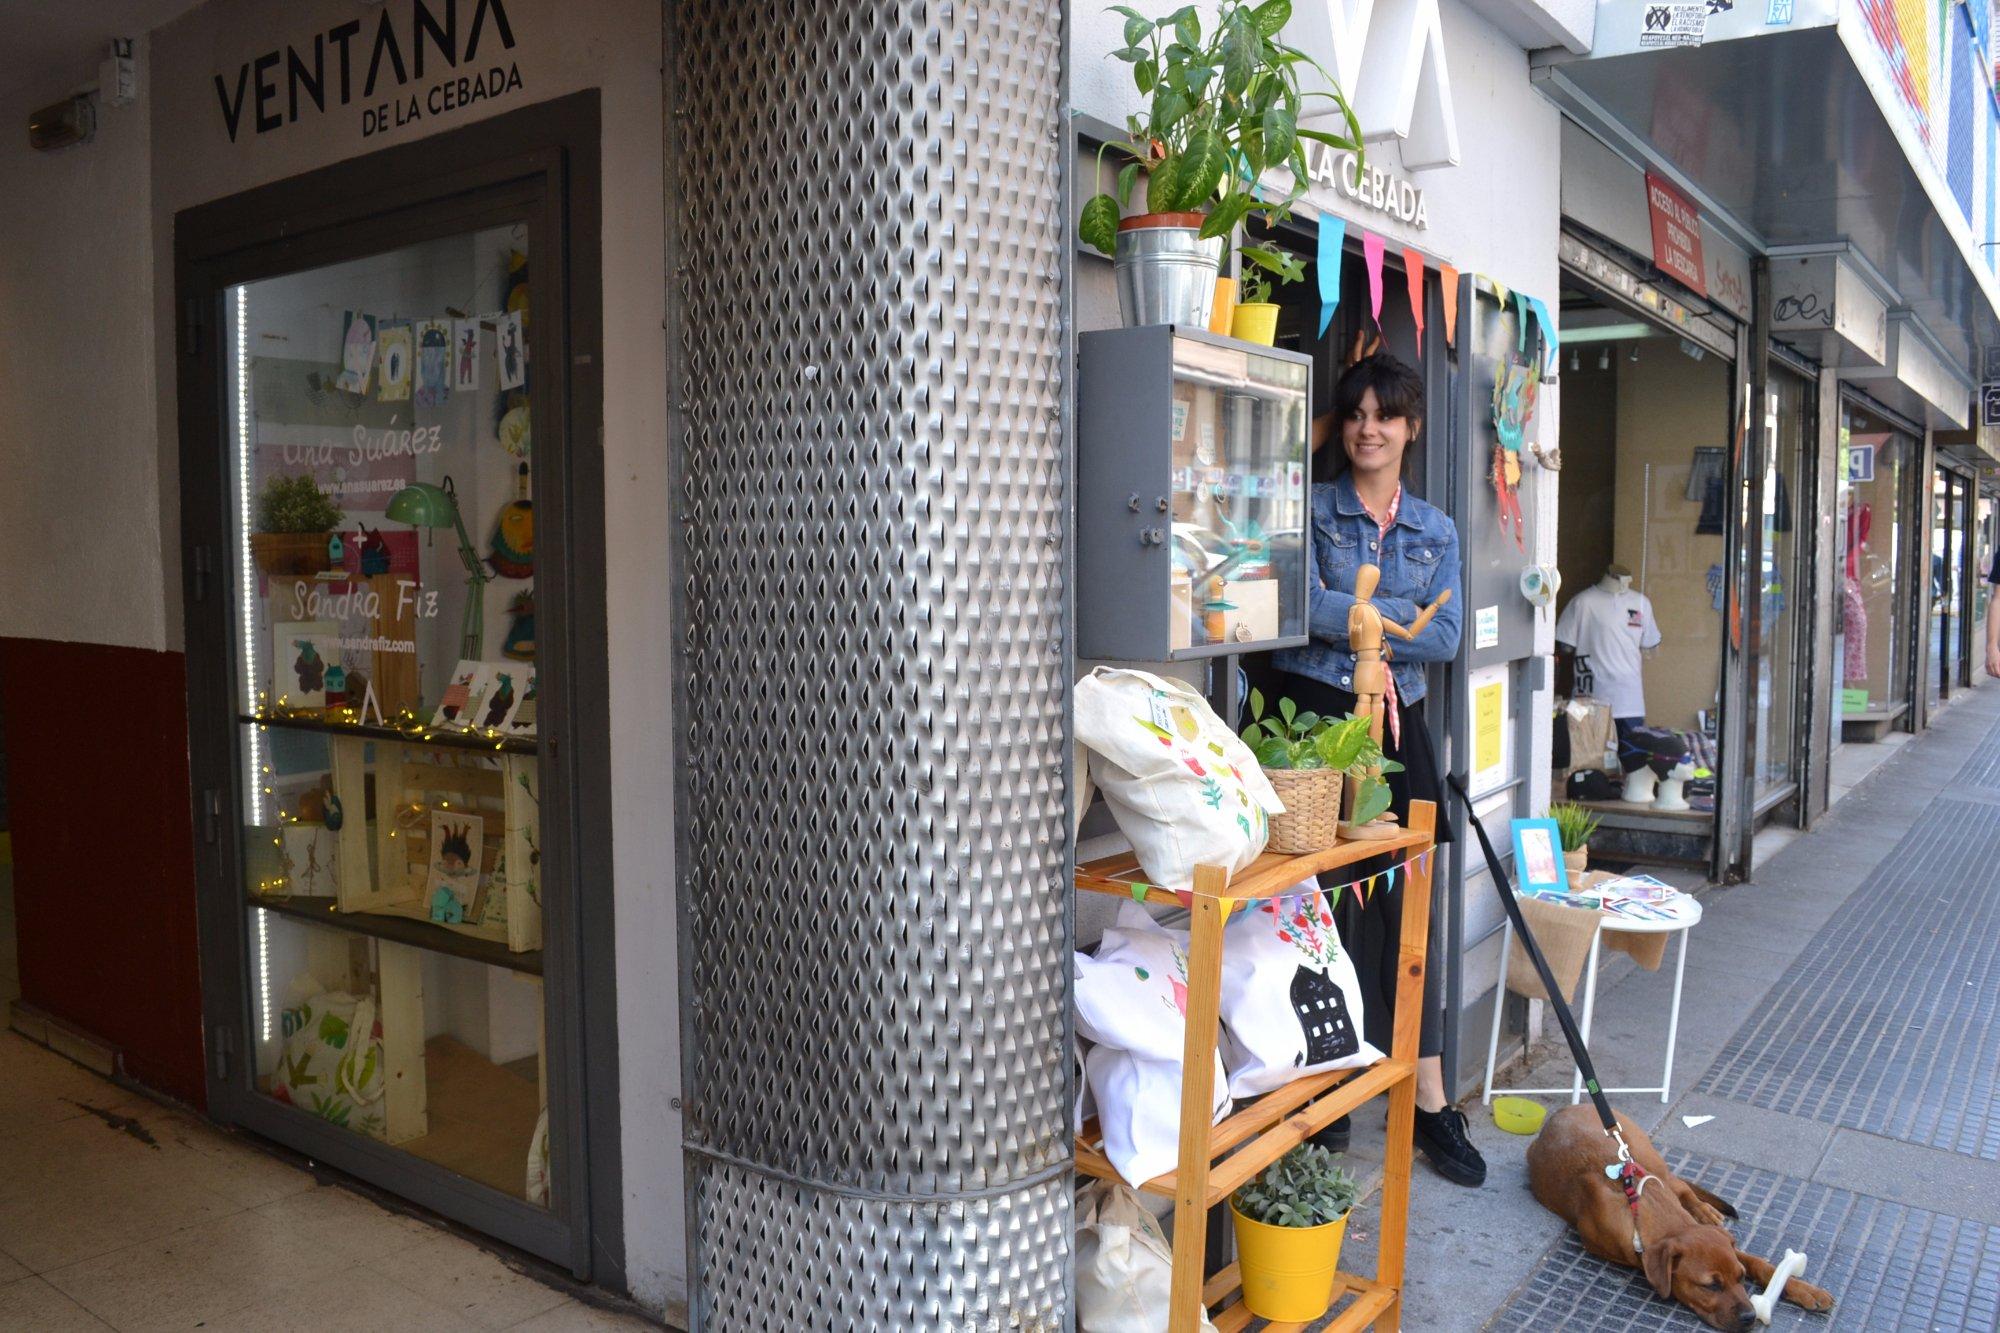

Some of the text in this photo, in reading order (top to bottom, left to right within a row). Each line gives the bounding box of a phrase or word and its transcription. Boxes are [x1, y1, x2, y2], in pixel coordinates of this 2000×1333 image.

[214, 0, 516, 144] VENTANA
[362, 62, 523, 138] DE LA CEBADA
[1306, 137, 1430, 230] LA CEBADA
[349, 414, 442, 466] Suárez
[290, 580, 439, 622] Sandra Fiz
